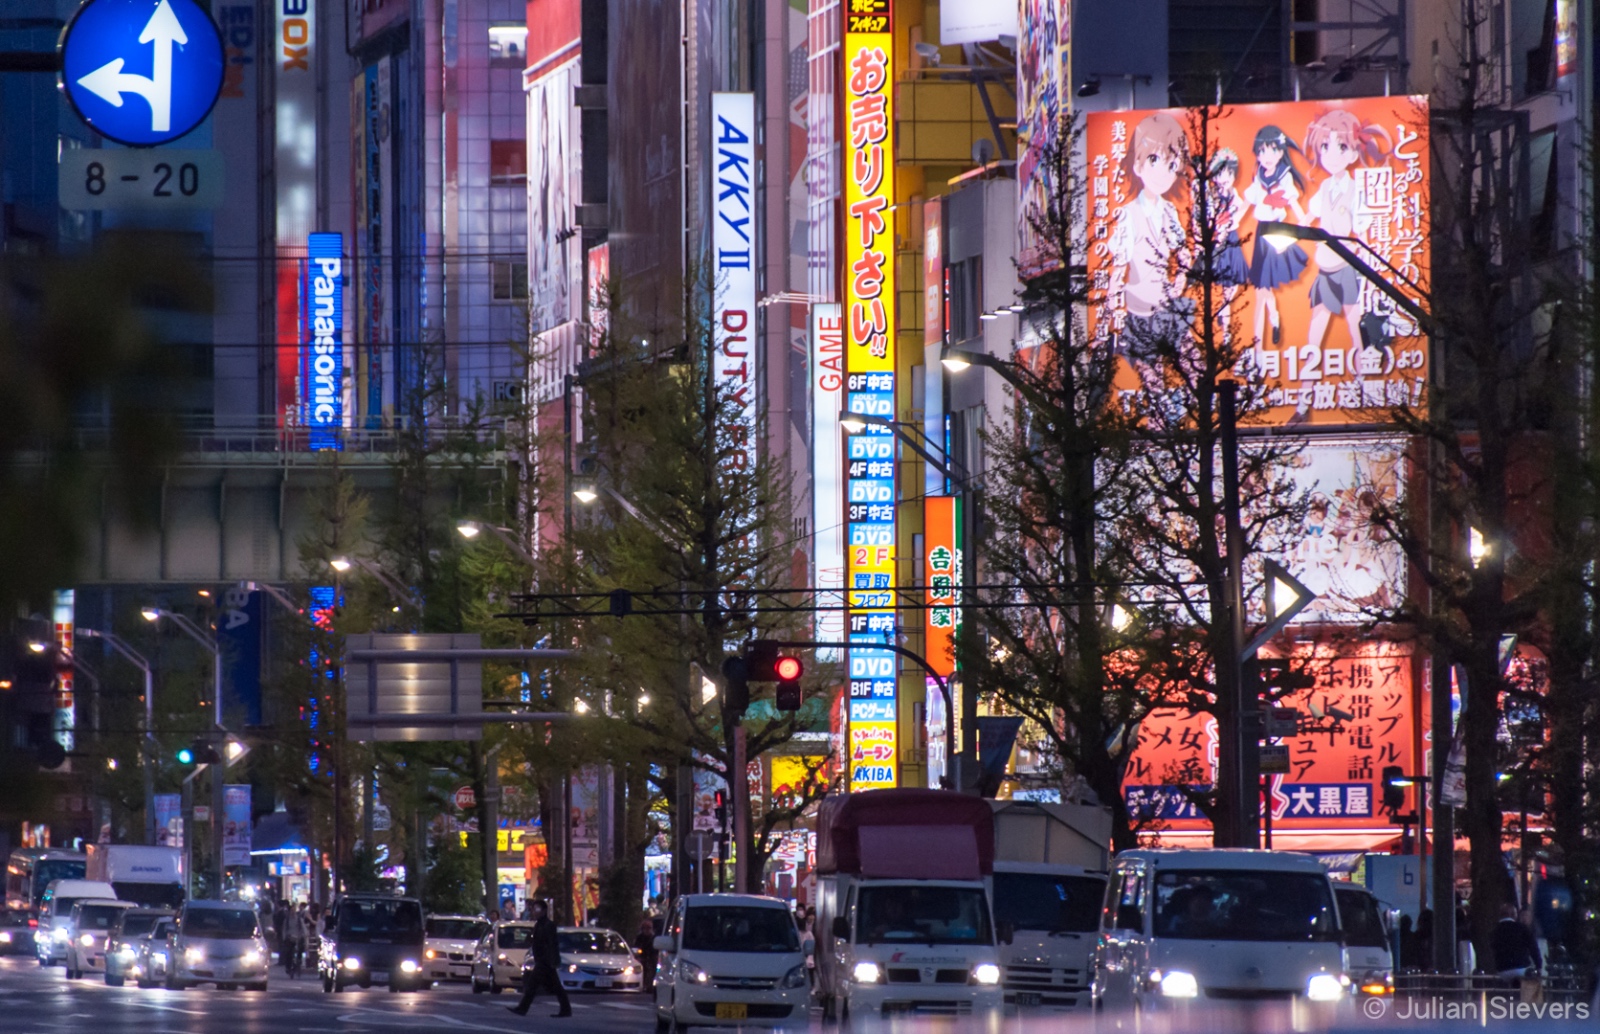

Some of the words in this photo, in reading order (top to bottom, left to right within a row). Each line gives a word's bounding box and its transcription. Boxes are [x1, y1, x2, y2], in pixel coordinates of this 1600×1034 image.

[850, 15, 887, 32] フィギュア
[718, 114, 750, 244] AKKY
[314, 256, 342, 423] Panasonic
[722, 309, 749, 409] DUTY
[819, 316, 843, 392] GAME
[848, 375, 867, 390] 6F
[867, 374, 893, 391] 中古
[851, 400, 891, 415] DVD
[851, 444, 891, 458] DVD
[849, 462, 867, 477] 4F
[867, 461, 894, 477] 中古
[852, 487, 892, 501] DVD
[849, 505, 867, 520] 3F
[868, 504, 894, 521] 中古
[852, 531, 892, 546] DVD
[854, 573, 891, 590] 買取
[851, 616, 867, 631] 1F
[868, 615, 894, 632] 中古
[852, 658, 893, 676] DVD
[851, 682, 872, 696] B1F
[873, 681, 895, 697] 中古
[852, 703, 895, 719] PCゲーム
[1348, 664, 1374, 780] 携帯電話
[853, 745, 893, 760] ムーラン
[853, 767, 893, 781] AKIBA
[1291, 786, 1369, 815] 大黒屋
